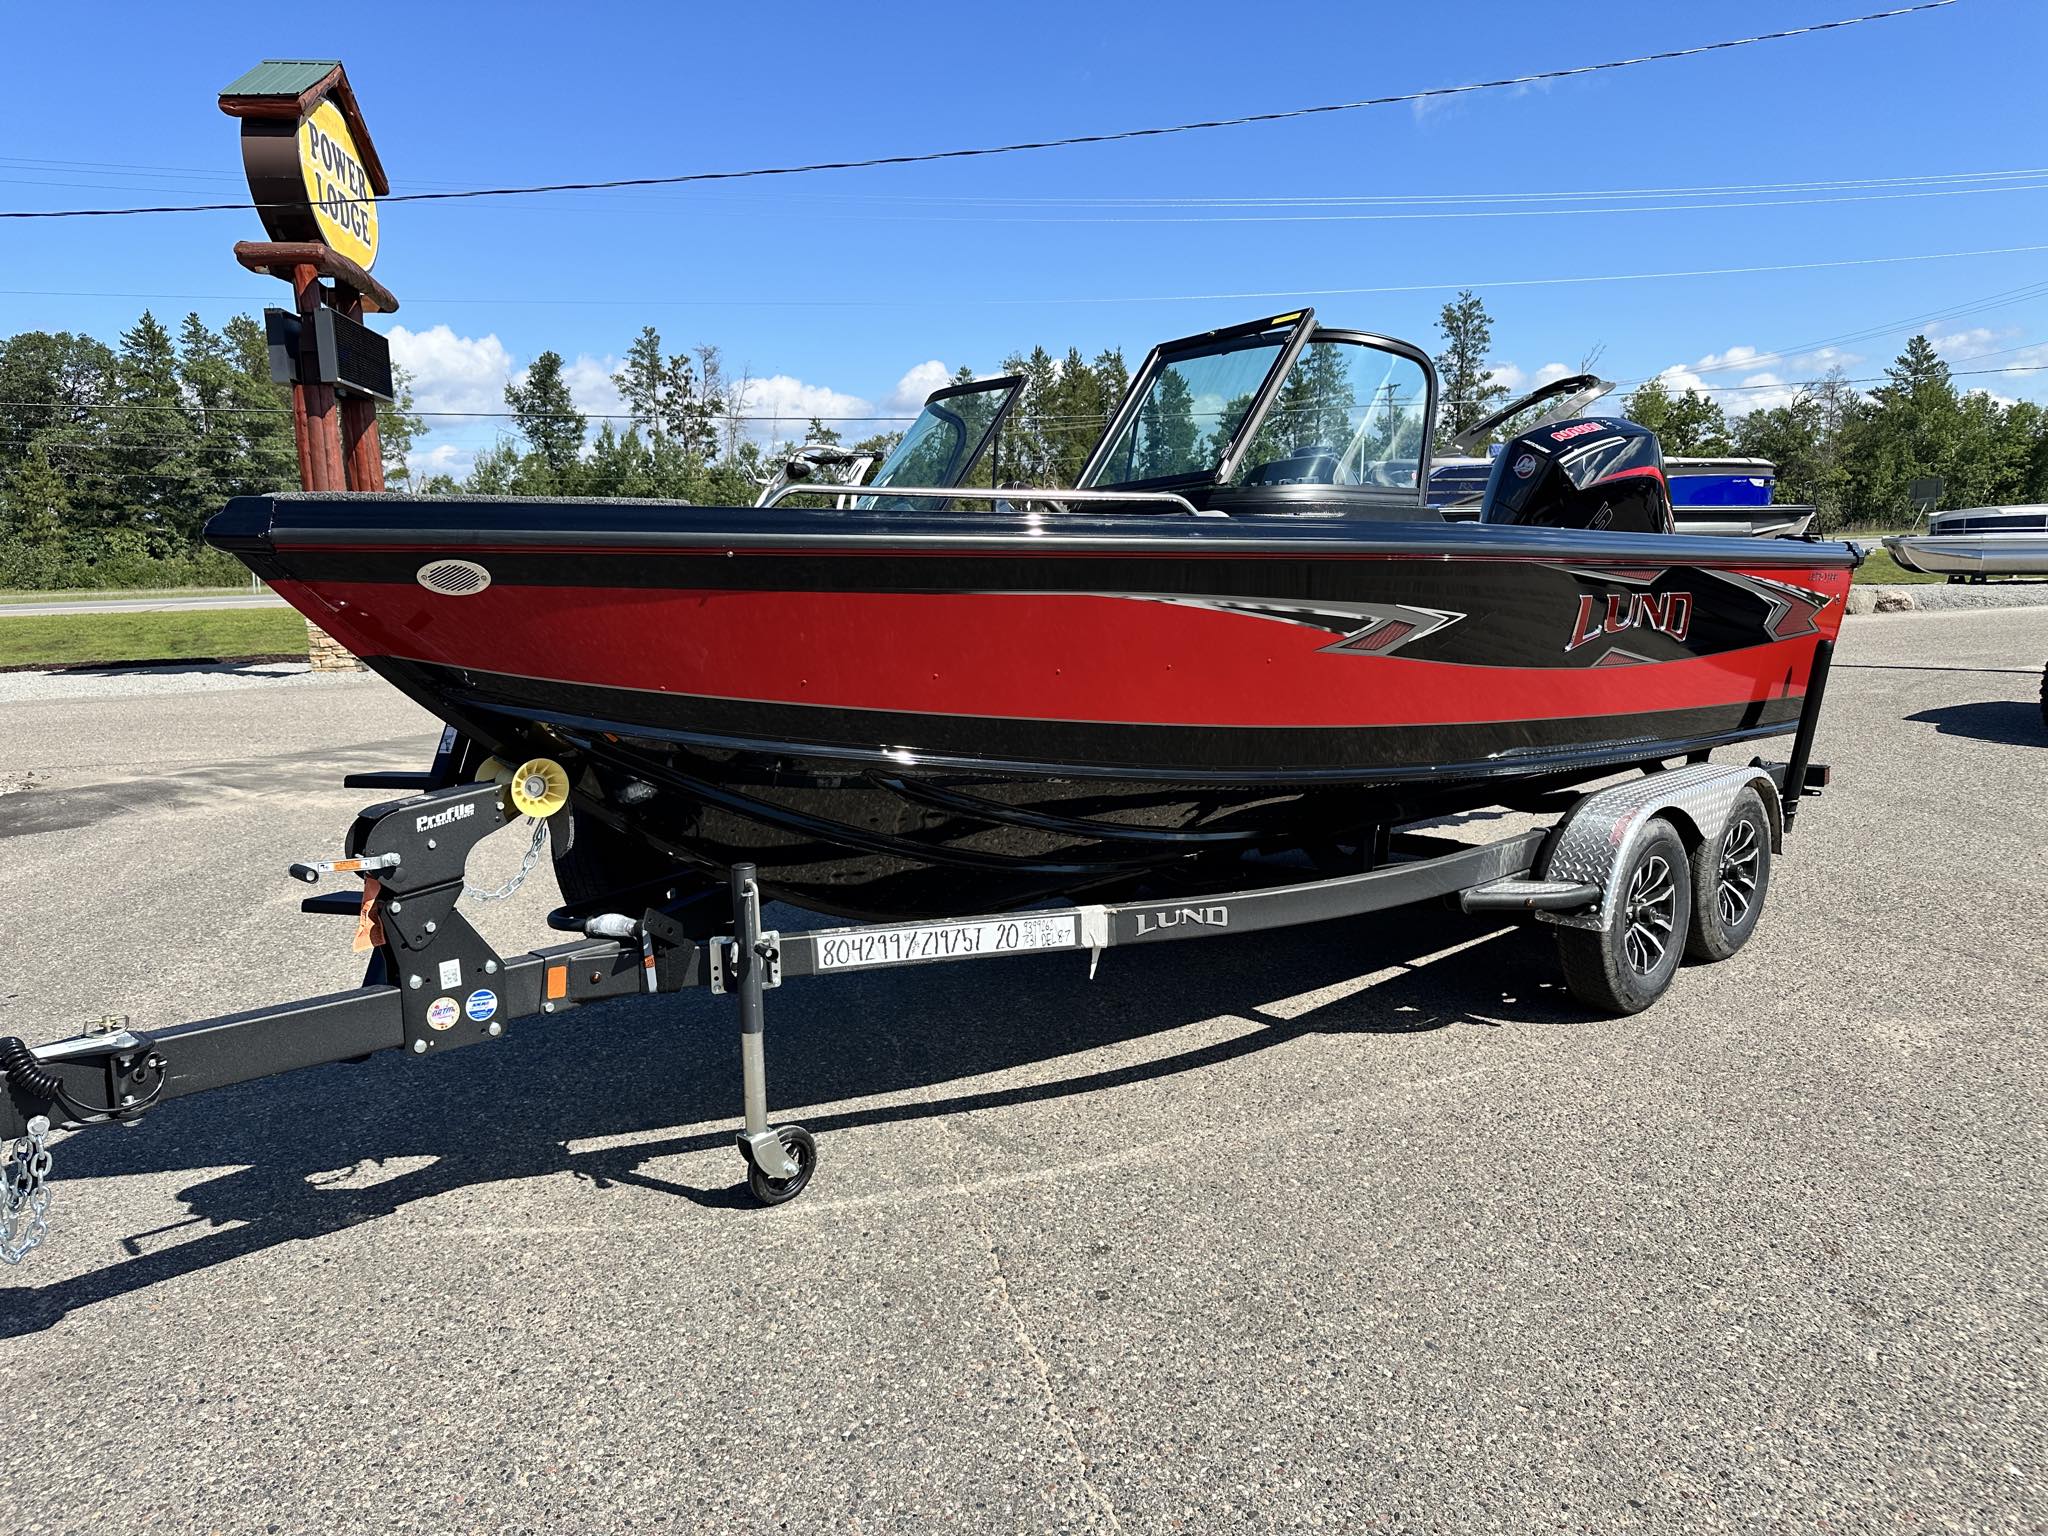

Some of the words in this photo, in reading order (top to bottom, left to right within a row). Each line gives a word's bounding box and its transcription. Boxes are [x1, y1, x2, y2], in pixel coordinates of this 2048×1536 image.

[308, 120, 369, 205] POWER
[315, 171, 371, 247] LODGE
[1563, 592, 1692, 652] LUND
[416, 803, 475, 830] Profile
[996, 923, 1019, 950] 20
[1135, 905, 1228, 937] LUND
